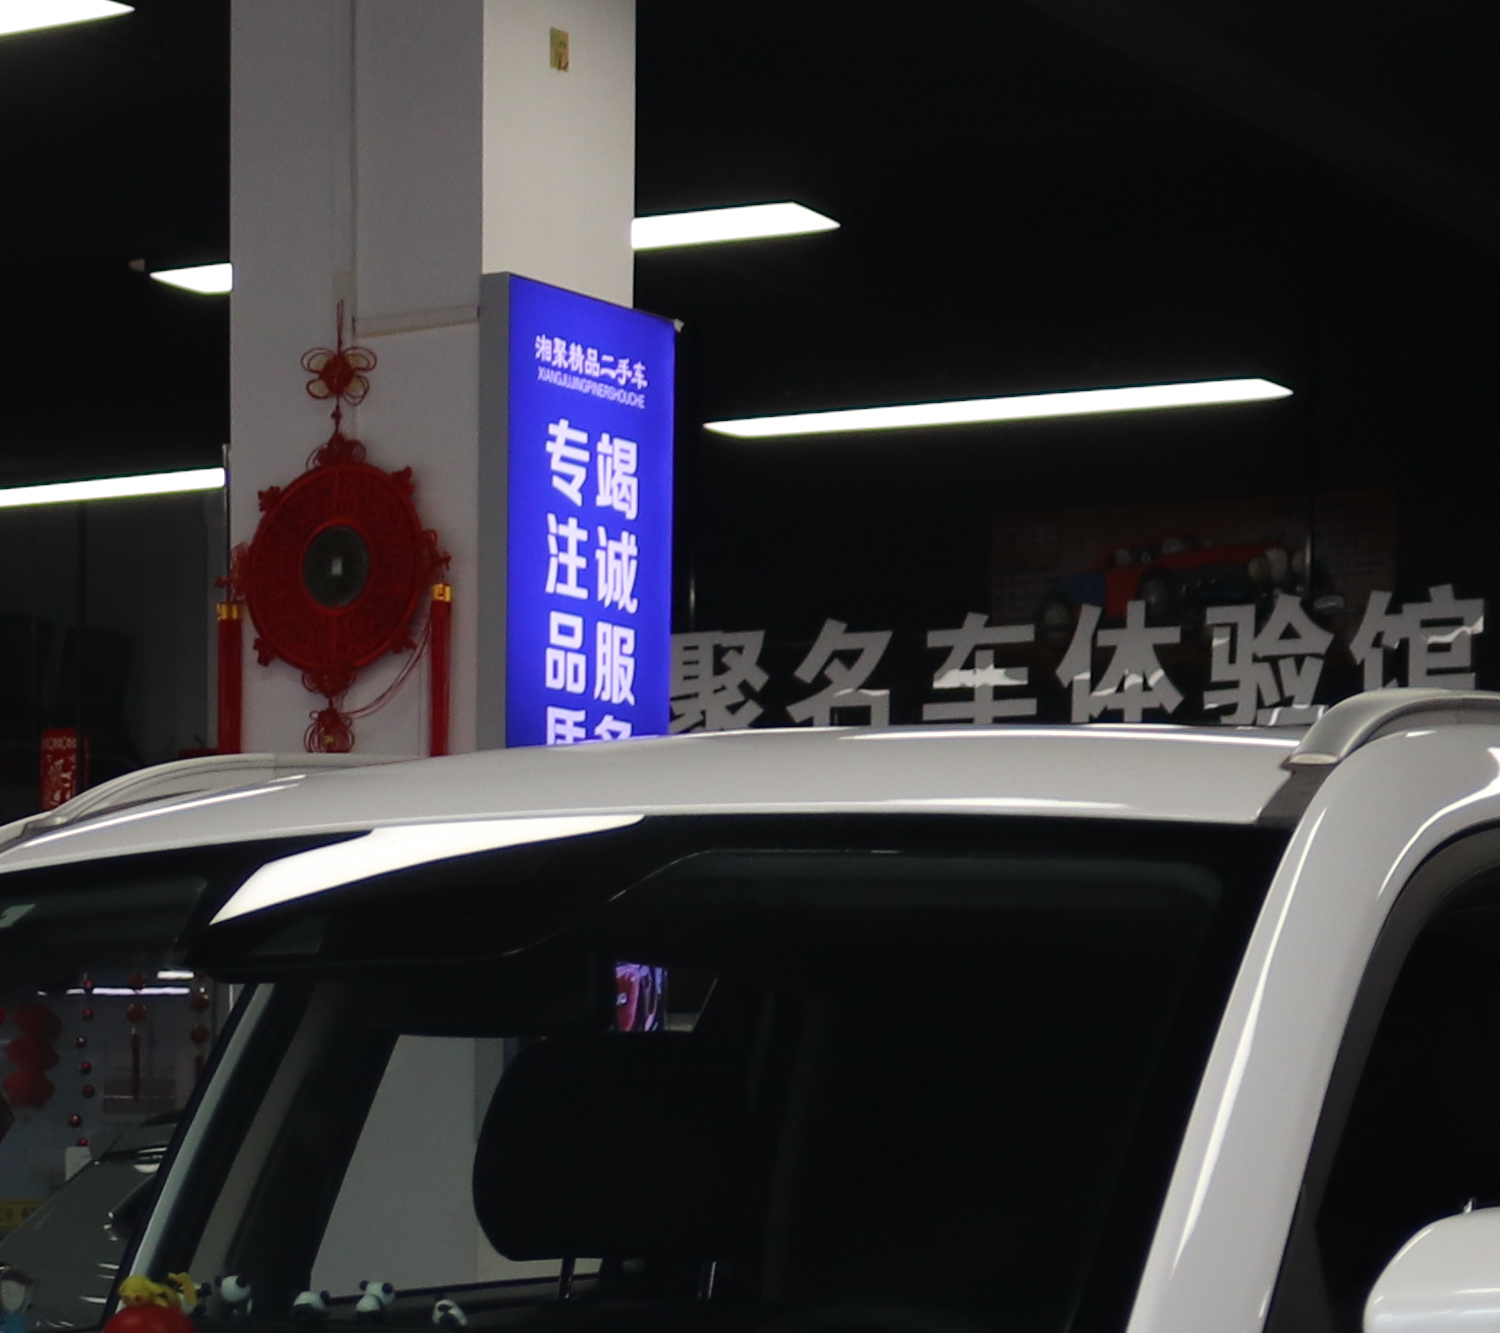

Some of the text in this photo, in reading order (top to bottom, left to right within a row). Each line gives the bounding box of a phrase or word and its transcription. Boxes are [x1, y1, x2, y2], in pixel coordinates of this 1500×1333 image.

[533, 333, 649, 391] 湘聚精品二手车
